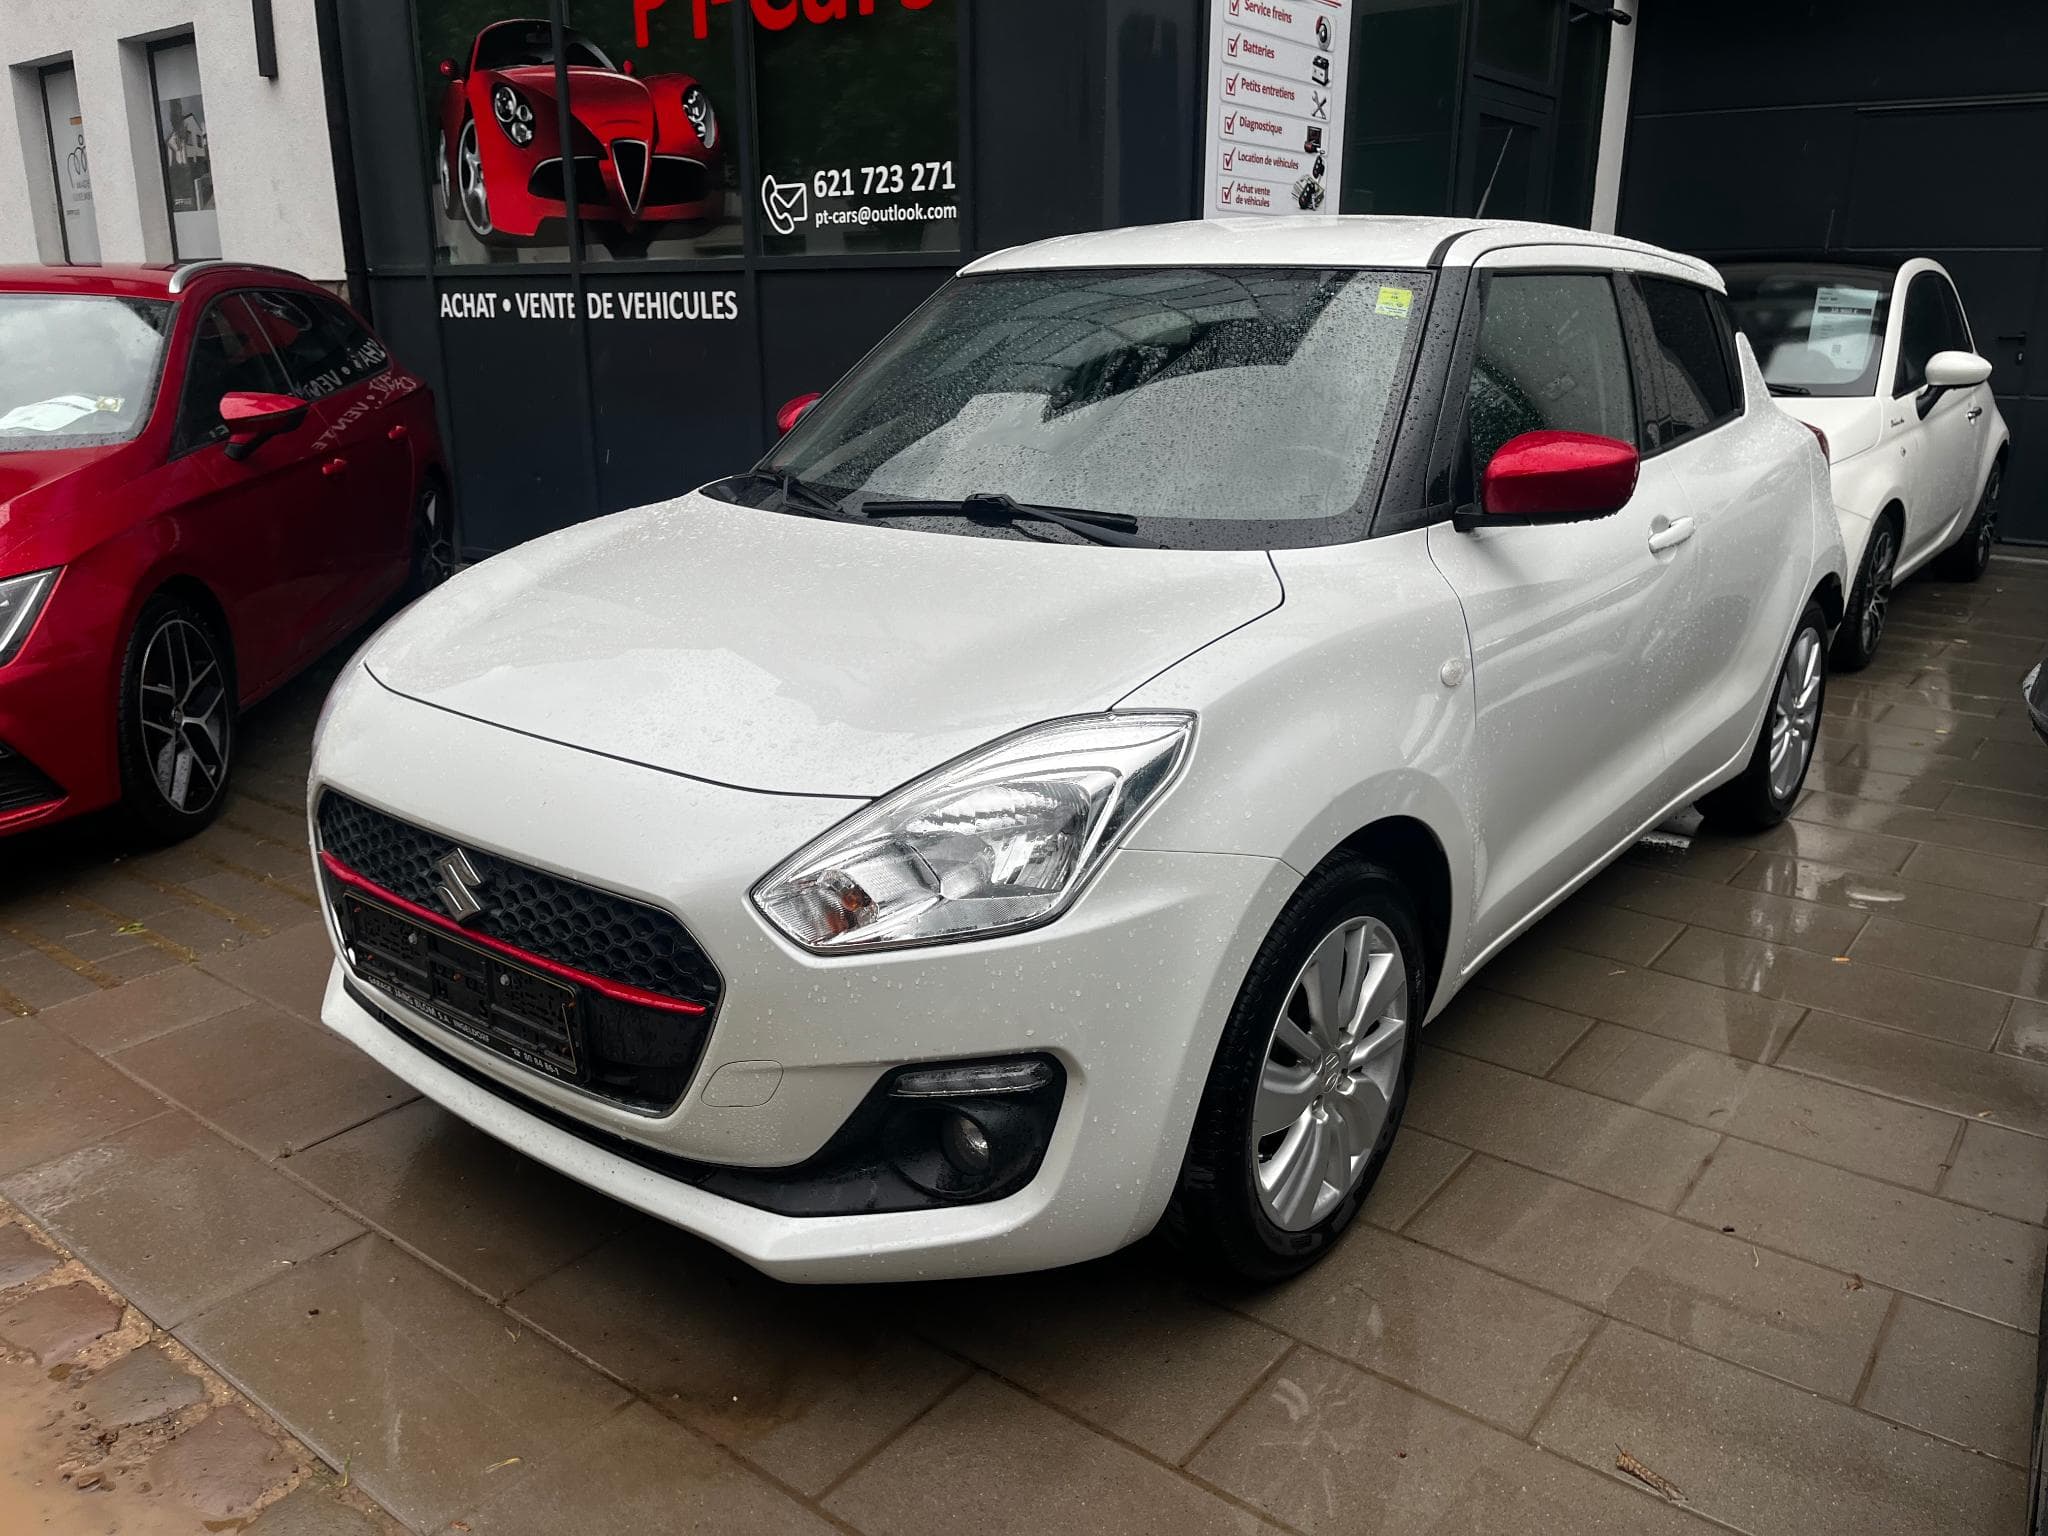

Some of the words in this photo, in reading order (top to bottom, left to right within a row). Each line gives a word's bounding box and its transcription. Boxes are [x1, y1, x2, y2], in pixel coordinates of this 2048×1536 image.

[1244, 0, 1272, 17] Service
[1273, 7, 1292, 24] freins
[1243, 40, 1275, 59] Batteries
[1241, 78, 1261, 93] Petits
[1262, 85, 1295, 101] entretiens
[1240, 117, 1282, 136] Diagnostique
[1238, 151, 1264, 165] Location
[1264, 157, 1272, 165] de
[1273, 159, 1299, 170] véhicules
[813, 169, 855, 198] 621
[861, 164, 904, 195] 723
[911, 161, 956, 192] 271
[1236, 183, 1254, 194] Achat
[1254, 187, 1271, 196] vente
[1235, 195, 1244, 204] de
[1244, 196, 1270, 207] véhicules
[815, 203, 957, 228] pt-cars@outlook.com
[440, 293, 497, 318] ACHAT
[515, 293, 576, 319] VENTE
[587, 293, 615, 319] DE
[617, 291, 738, 320] VEHICULES
